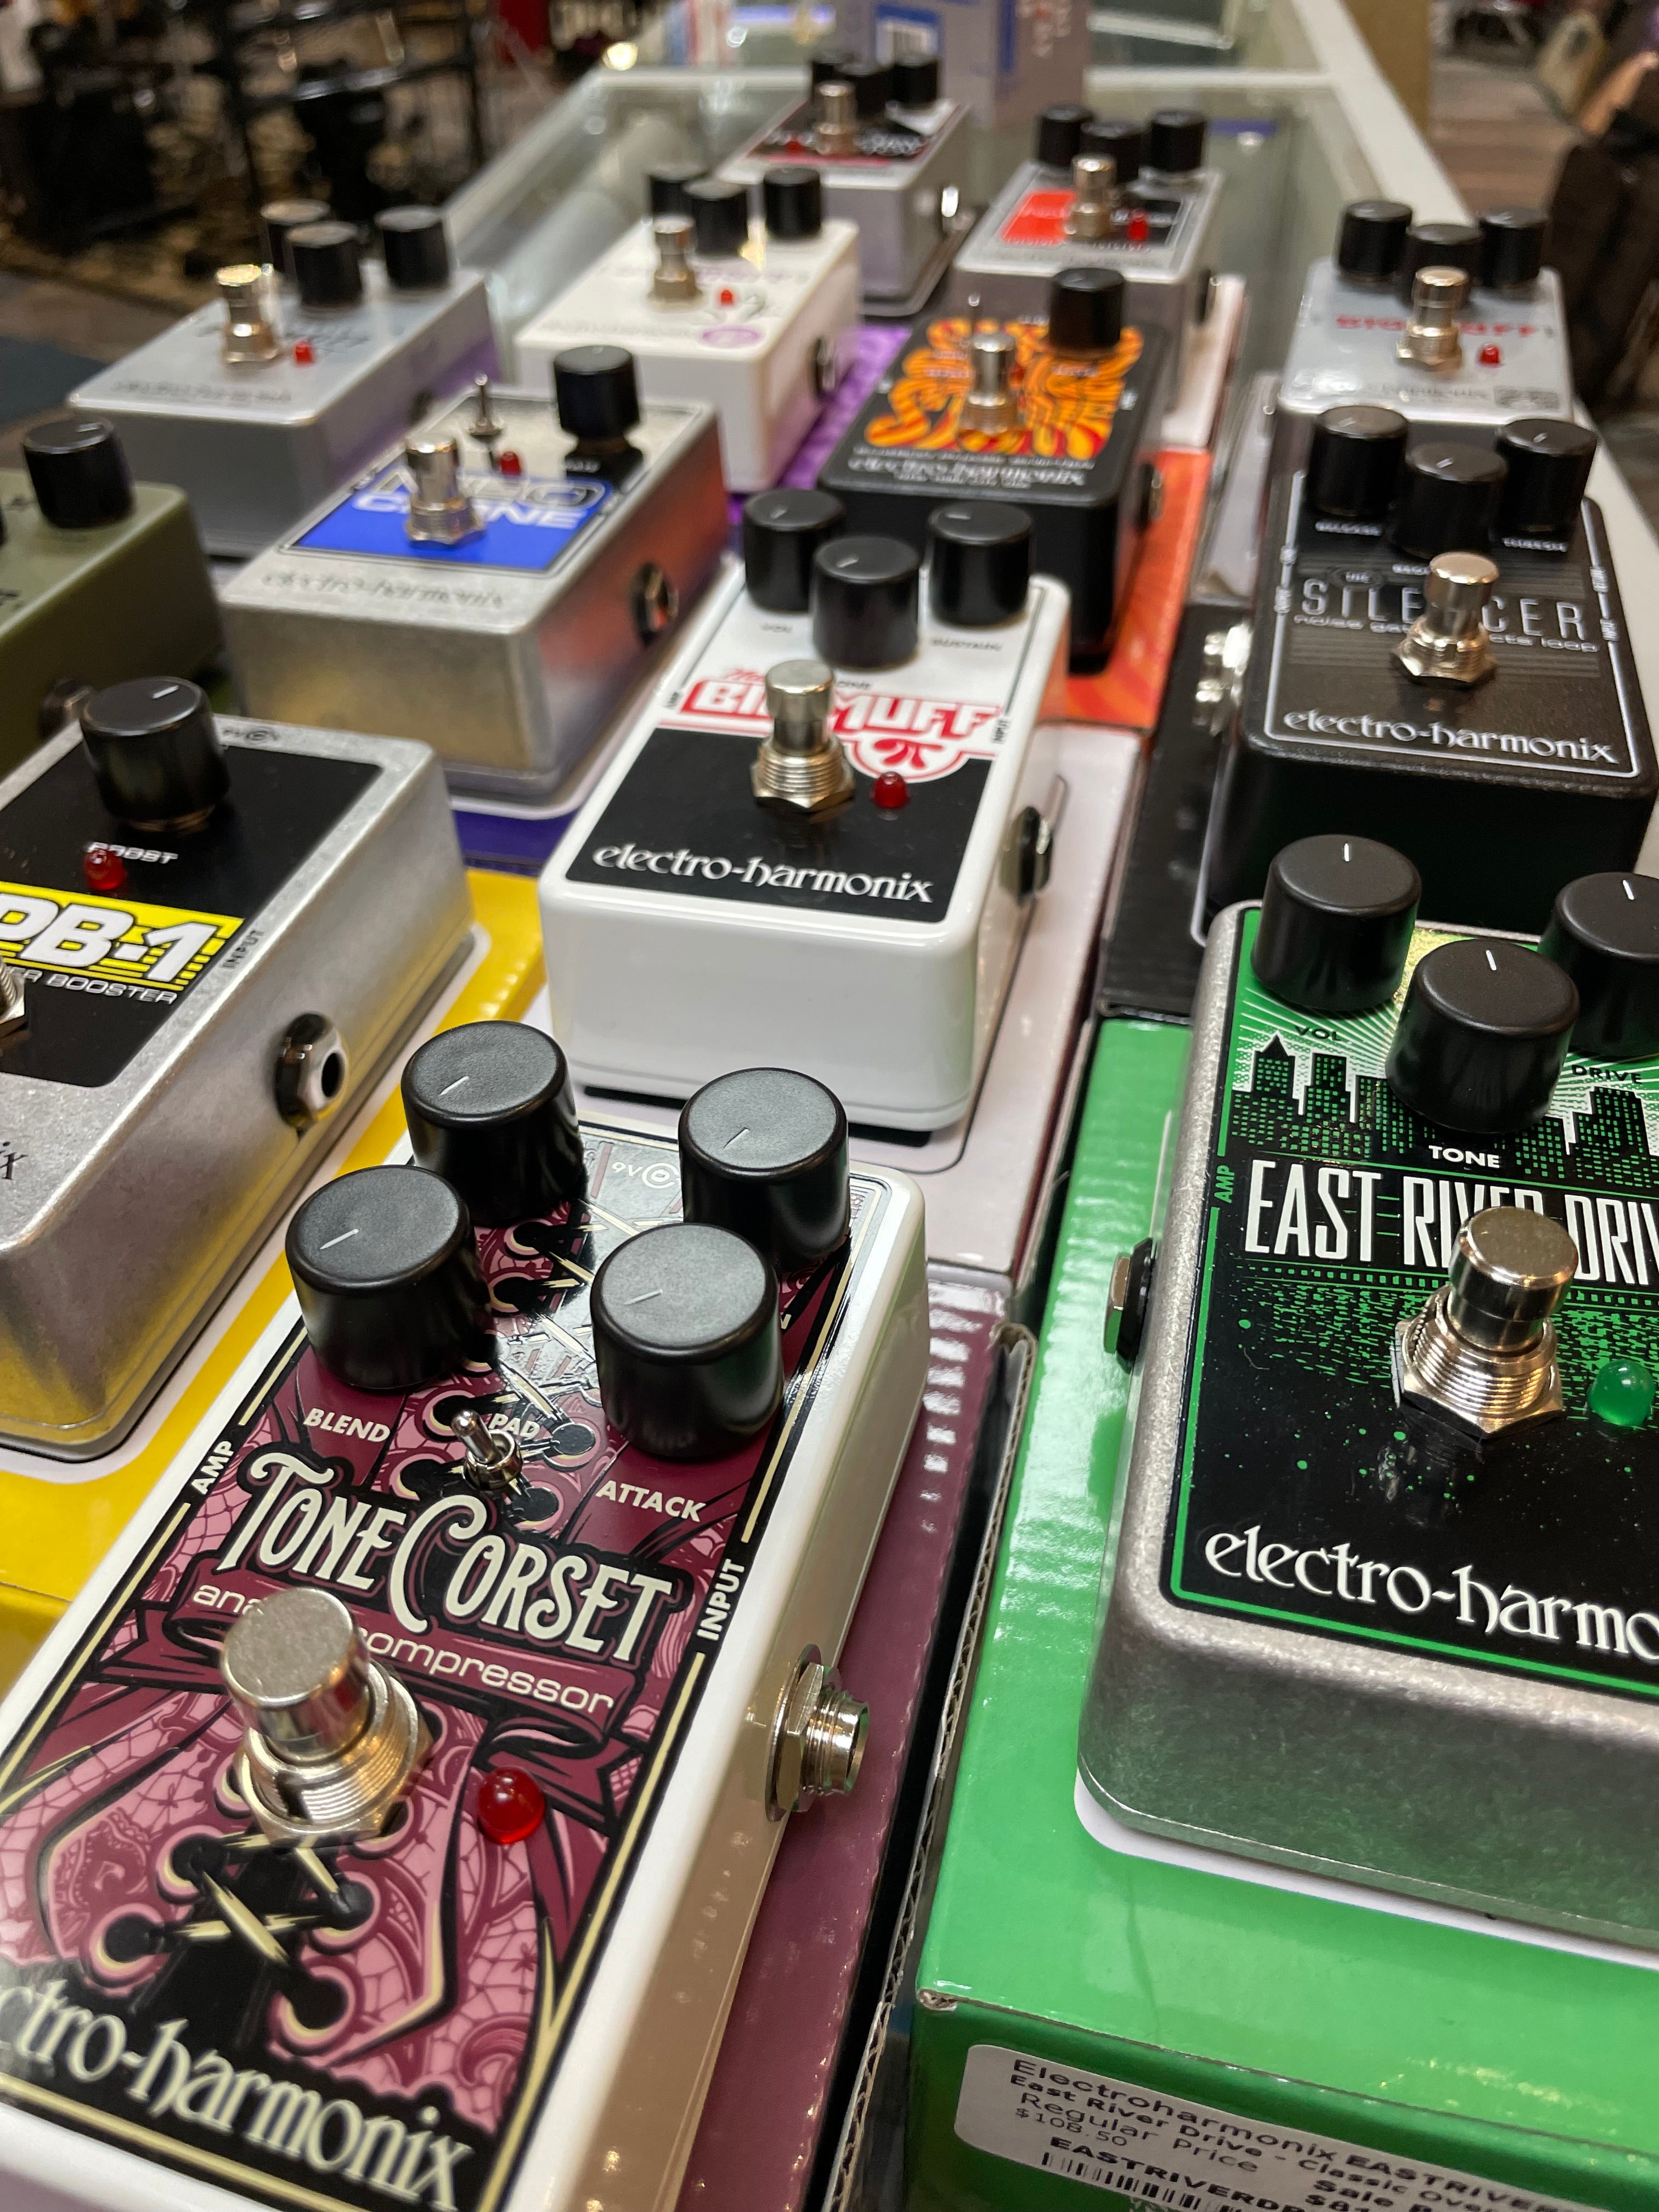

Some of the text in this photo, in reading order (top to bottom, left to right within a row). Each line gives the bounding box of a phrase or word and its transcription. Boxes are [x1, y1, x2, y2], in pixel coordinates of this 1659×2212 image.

[1301, 578, 1585, 641] SILECER
[681, 679, 769, 720] BI
[1284, 708, 1621, 764] electro-harmonix
[592, 842, 934, 903] electro-harmonix
[47, 973, 178, 1006] BOOSTER
[1295, 1025, 1342, 1042] VOL
[1572, 1064, 1642, 1085] DRIVE
[1429, 1144, 1501, 1169] TONE
[1214, 1165, 1235, 1204] AMP
[1244, 1159, 1383, 1262] EAST
[303, 1407, 391, 1443] BLEND
[489, 1413, 541, 1440] PAD
[194, 1440, 236, 1496] AMP
[596, 1479, 707, 1523] ATTACK
[696, 1558, 749, 1641] INPUT
[358, 1626, 614, 1715] ompressor
[1010, 2073, 1077, 2103] East
[1086, 2096, 1170, 2129] River
[1179, 2123, 1263, 2158] Drive
[1297, 2158, 1408, 2194] Classic
[1013, 2058, 1338, 2162] Electroharmonix
[1015, 2107, 1128, 2147] $108.50
[1020, 2091, 1158, 2141] Regular
[1172, 2137, 1259, 2173] Price
